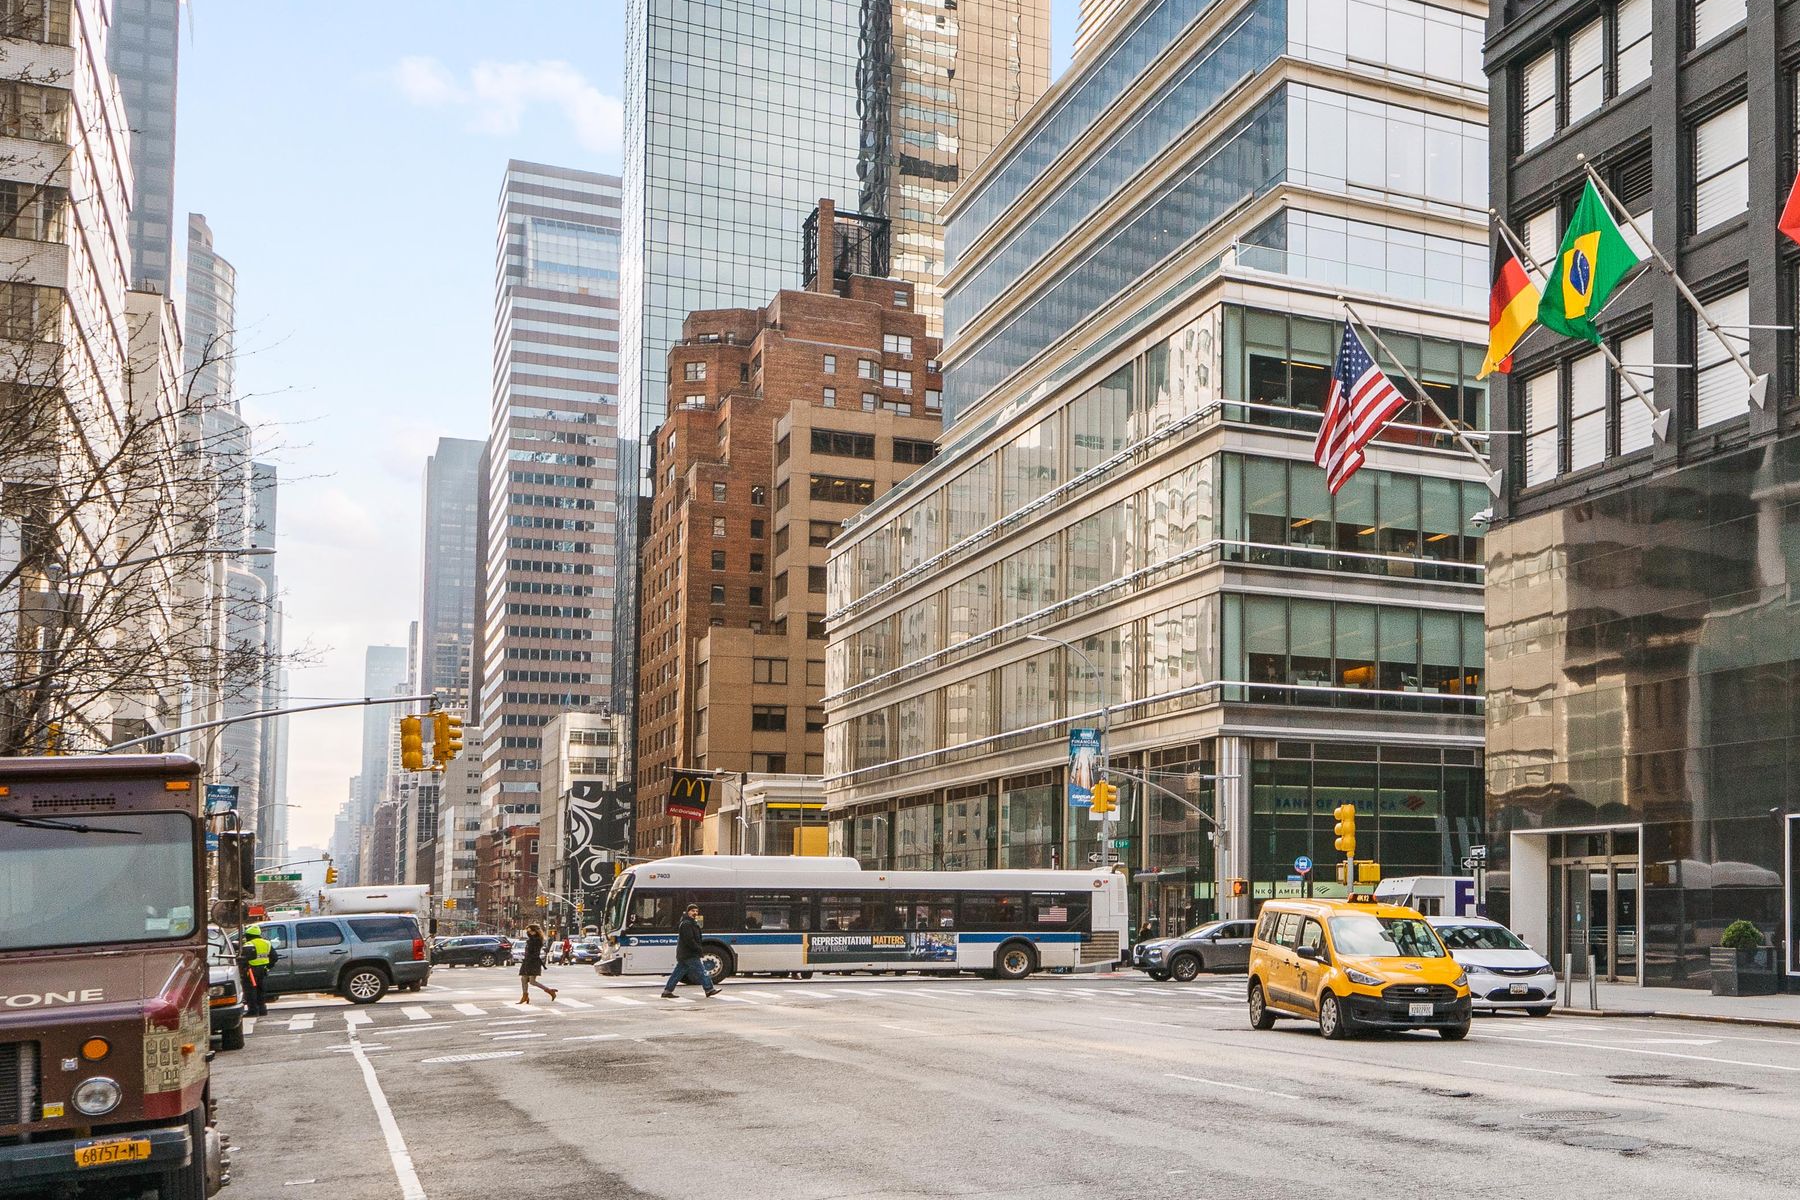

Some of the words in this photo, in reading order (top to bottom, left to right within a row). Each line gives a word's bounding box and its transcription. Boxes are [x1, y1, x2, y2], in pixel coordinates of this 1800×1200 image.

[811, 936, 872, 946] REPRESENTATION
[872, 935, 906, 945] MATTERS.
[0, 988, 104, 1007] ONE
